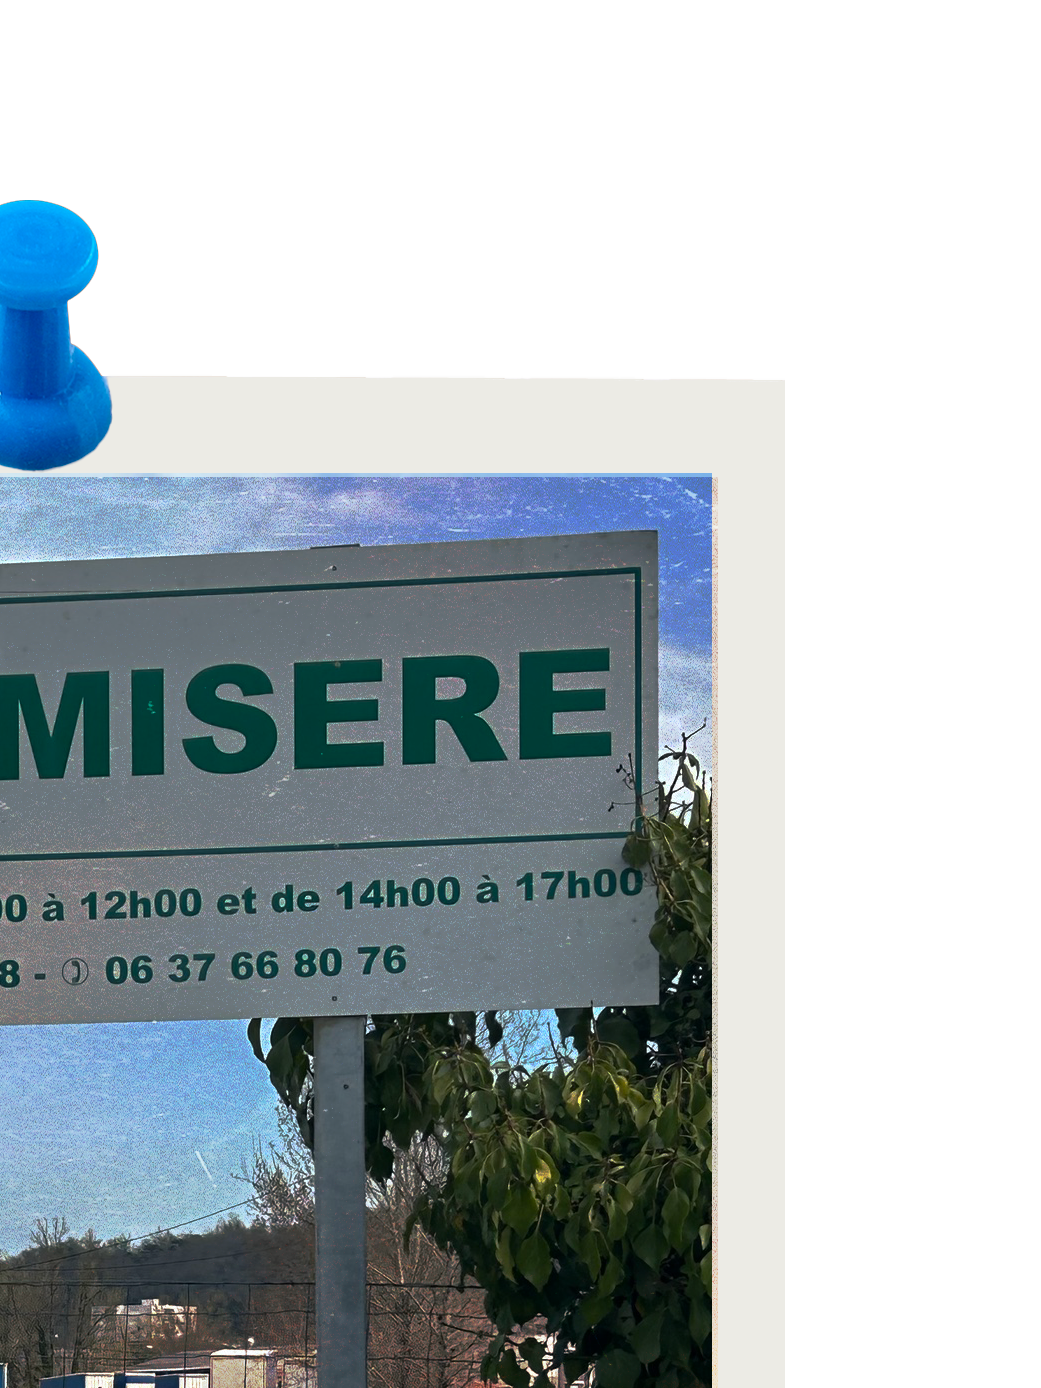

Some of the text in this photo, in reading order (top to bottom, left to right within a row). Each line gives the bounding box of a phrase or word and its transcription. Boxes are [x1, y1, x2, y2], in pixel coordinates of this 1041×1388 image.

[42, 892, 64, 922] à
[80, 888, 202, 920] 12h00
[216, 887, 257, 916] et
[271, 884, 320, 913] de
[335, 876, 461, 910] 14h00
[476, 874, 499, 904] à
[515, 867, 644, 901] 17h00
[105, 955, 154, 985] 06
[169, 953, 216, 983] 37
[231, 950, 279, 980] 66
[294, 948, 342, 978] 80
[357, 945, 407, 975] 76
